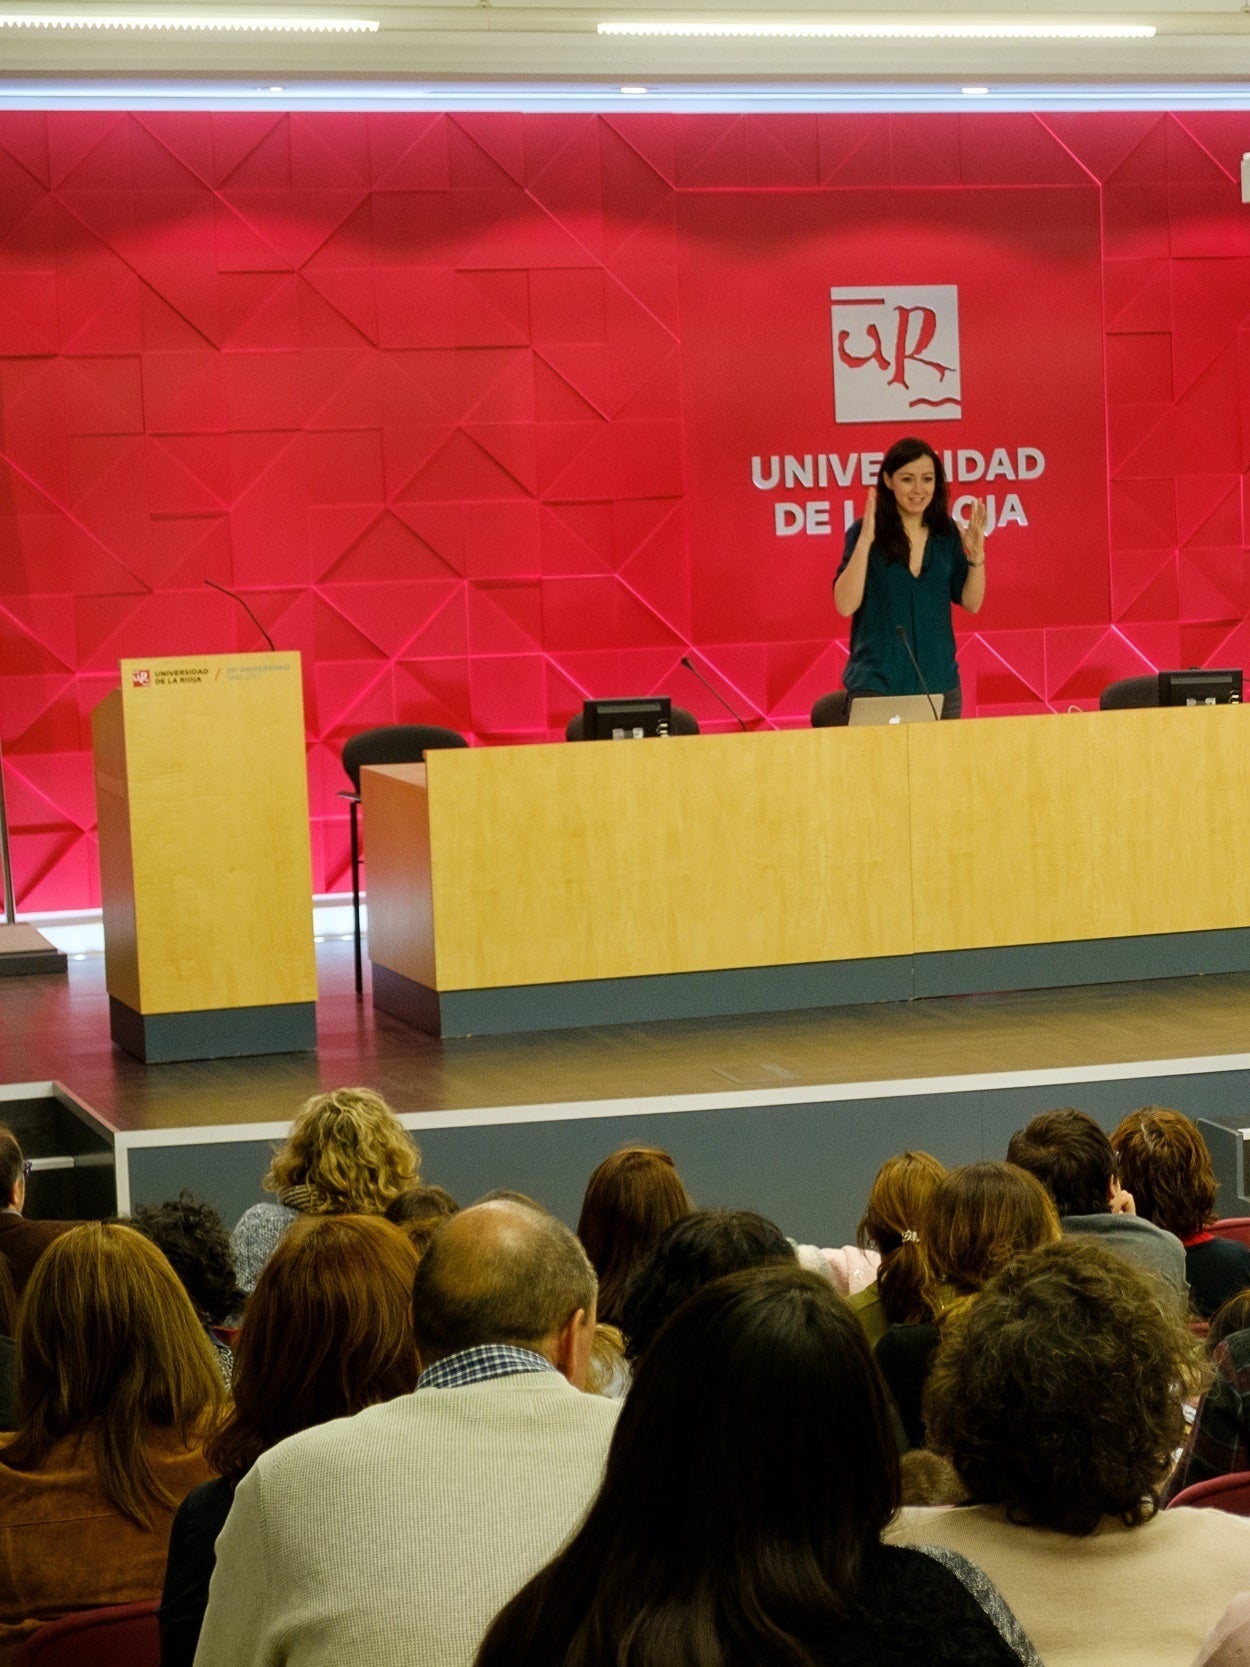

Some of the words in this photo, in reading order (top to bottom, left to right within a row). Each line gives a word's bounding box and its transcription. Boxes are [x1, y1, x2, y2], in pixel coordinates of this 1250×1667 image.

[750, 447, 1046, 490] UNIVEIDAD
[774, 501, 831, 537] DE
[154, 668, 209, 677] UNIVERSIDAD
[180, 676, 201, 684] RIOJA
